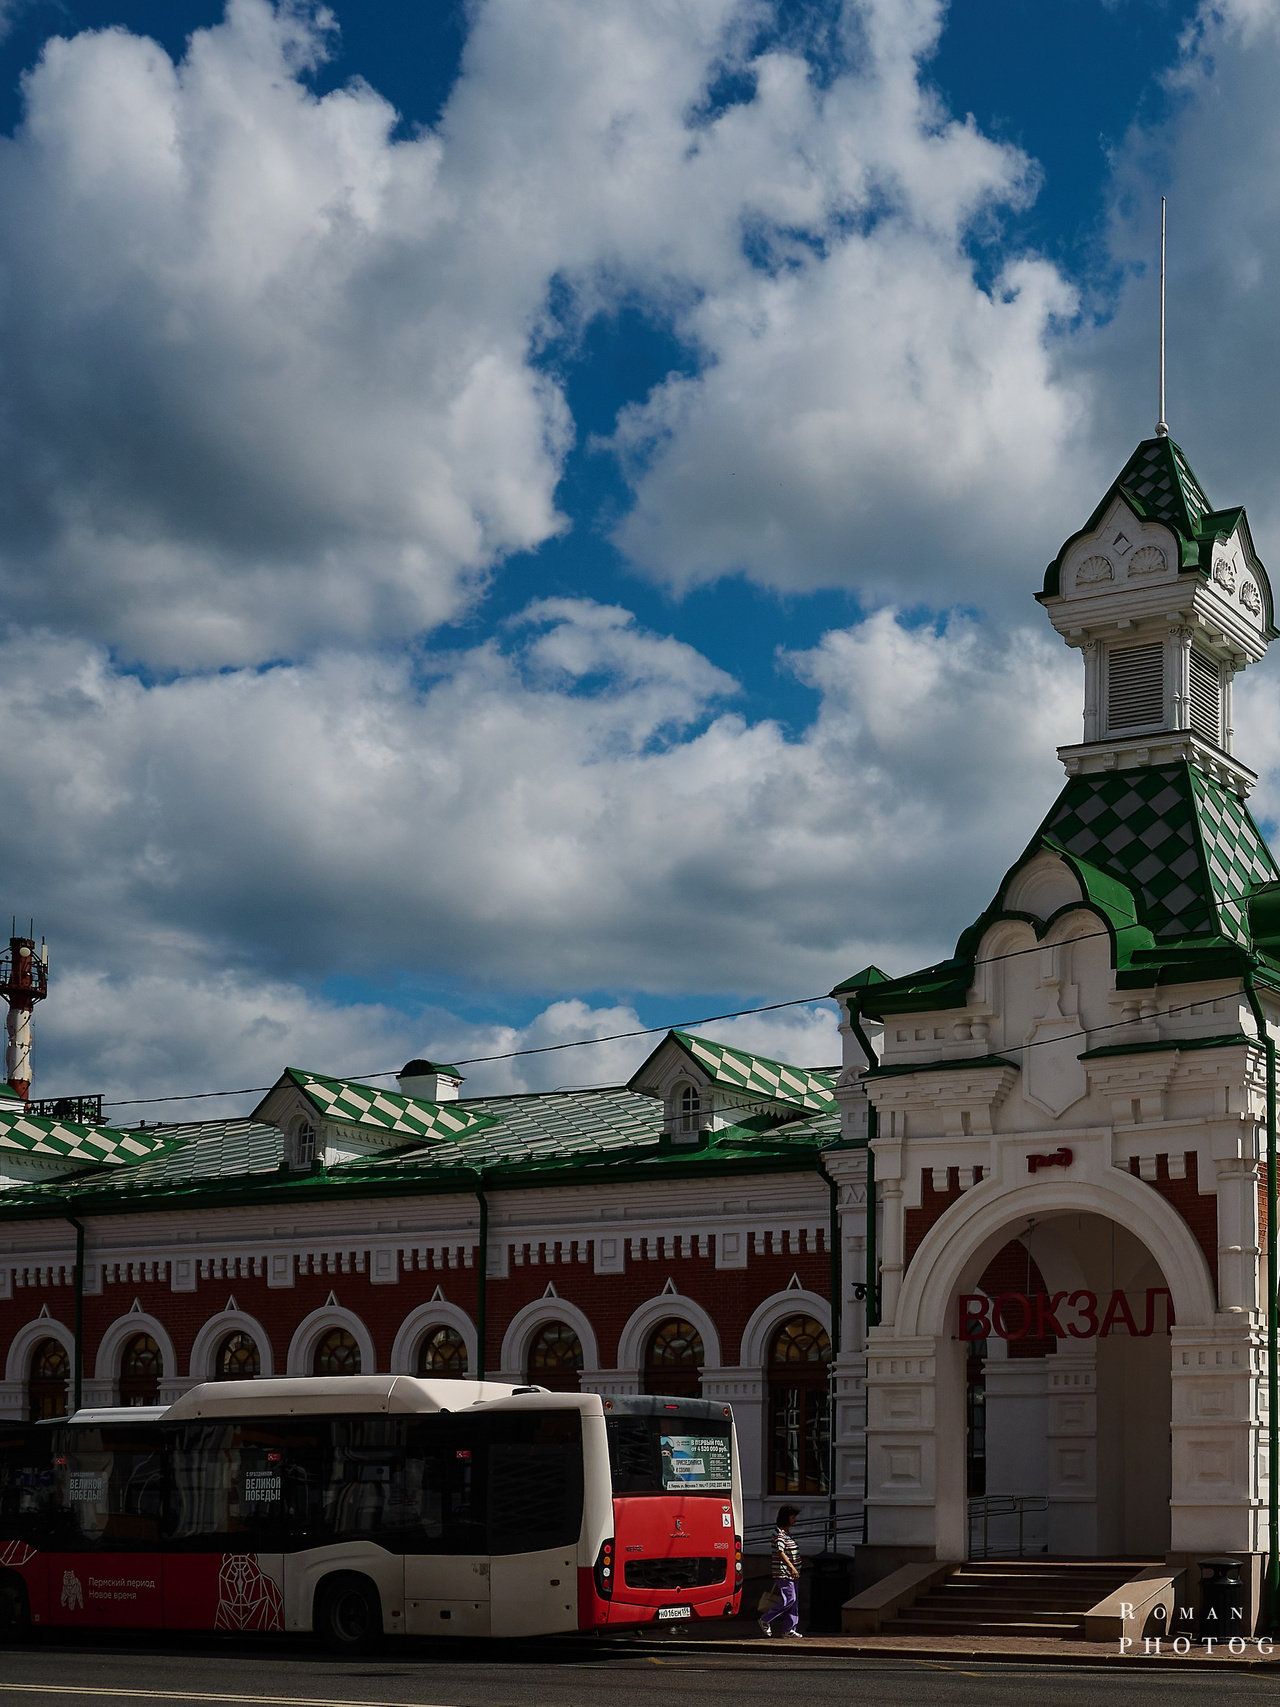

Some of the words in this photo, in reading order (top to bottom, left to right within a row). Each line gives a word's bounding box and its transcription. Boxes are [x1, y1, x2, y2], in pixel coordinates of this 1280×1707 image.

[959, 1287, 1175, 1341] ВОКЗАЛ
[70, 1478, 102, 1489] ВЕЛИКОЙ
[246, 1477, 281, 1489] ВЕЛИКОЙ
[69, 1490, 102, 1502] ПОБЕДЫ!
[245, 1489, 281, 1502] ПОБЕДЫ!
[89, 1577, 126, 1588] Пермский
[127, 1579, 156, 1589] период
[89, 1590, 112, 1599] Новое
[113, 1592, 137, 1601] время
